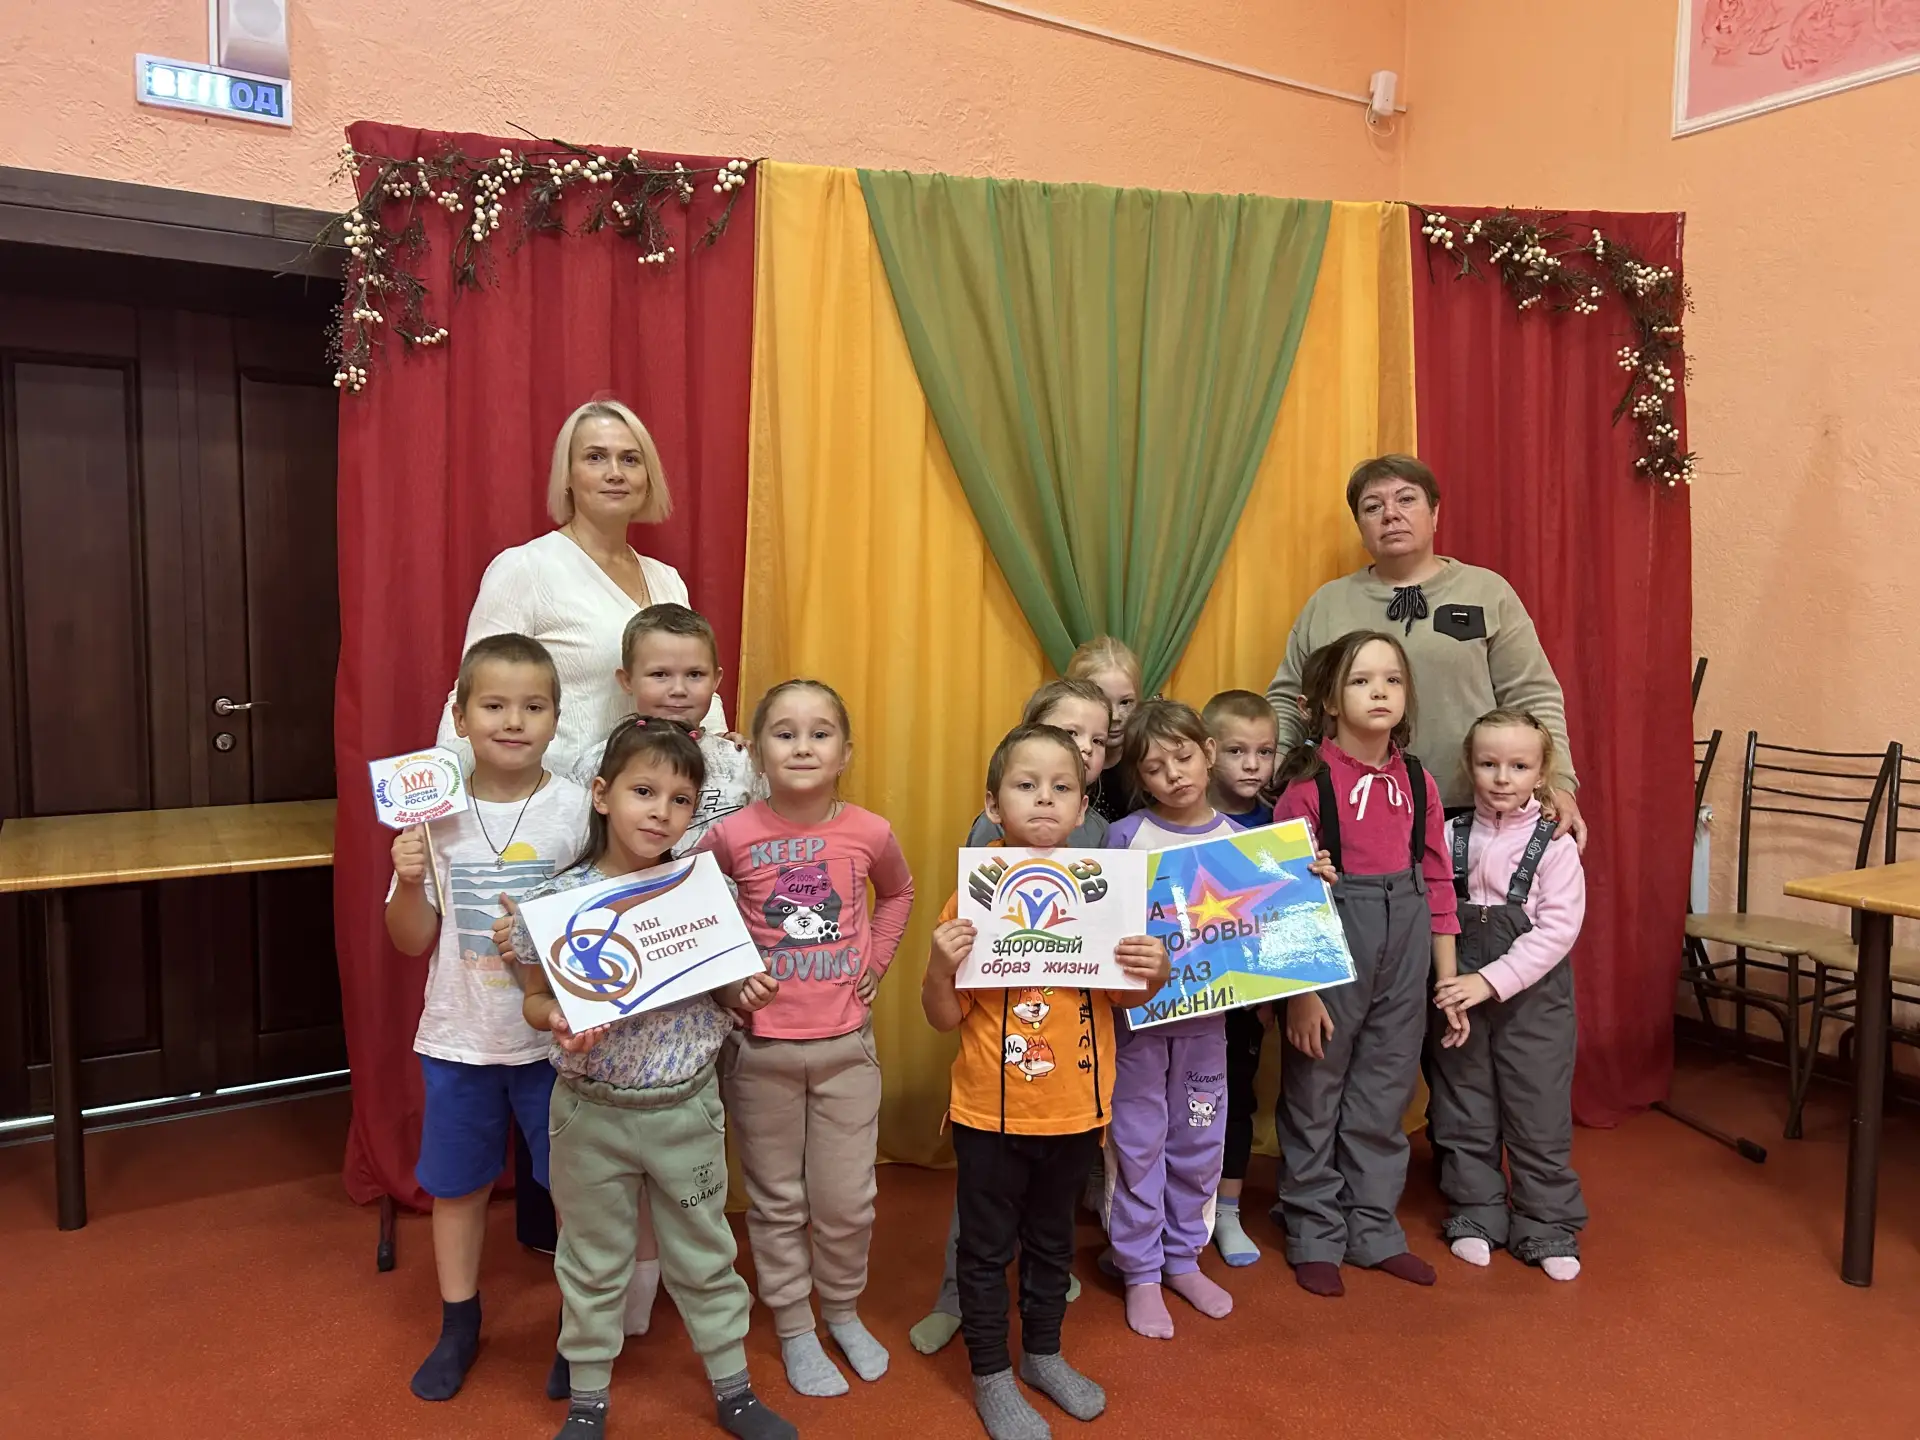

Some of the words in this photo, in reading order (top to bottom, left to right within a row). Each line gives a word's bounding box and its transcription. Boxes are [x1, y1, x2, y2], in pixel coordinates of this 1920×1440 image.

[376, 779, 394, 808] СМЕЛО!
[404, 788, 438, 800] ЗДОРОВАЯ
[404, 793, 439, 806] РОССИЯ
[394, 816, 422, 824] ОБРАЗ
[424, 804, 455, 820] ЖИЗНИ
[409, 799, 450, 817] ЗДОРОВЫЙ
[750, 837, 826, 868] KEEP
[788, 883, 819, 895] CUTE
[633, 916, 661, 934] МЫ
[639, 915, 719, 948] ВЫБИРАЕМ
[646, 938, 698, 962] СПОРТ!
[992, 936, 1083, 957] здоровый
[763, 946, 861, 982] OVING
[981, 959, 1030, 977] образ
[1043, 961, 1099, 975] жизни
[1167, 960, 1212, 988] РАЗ
[1142, 986, 1235, 1024] ЖИЗНИ!
[1008, 1040, 1022, 1055] No
